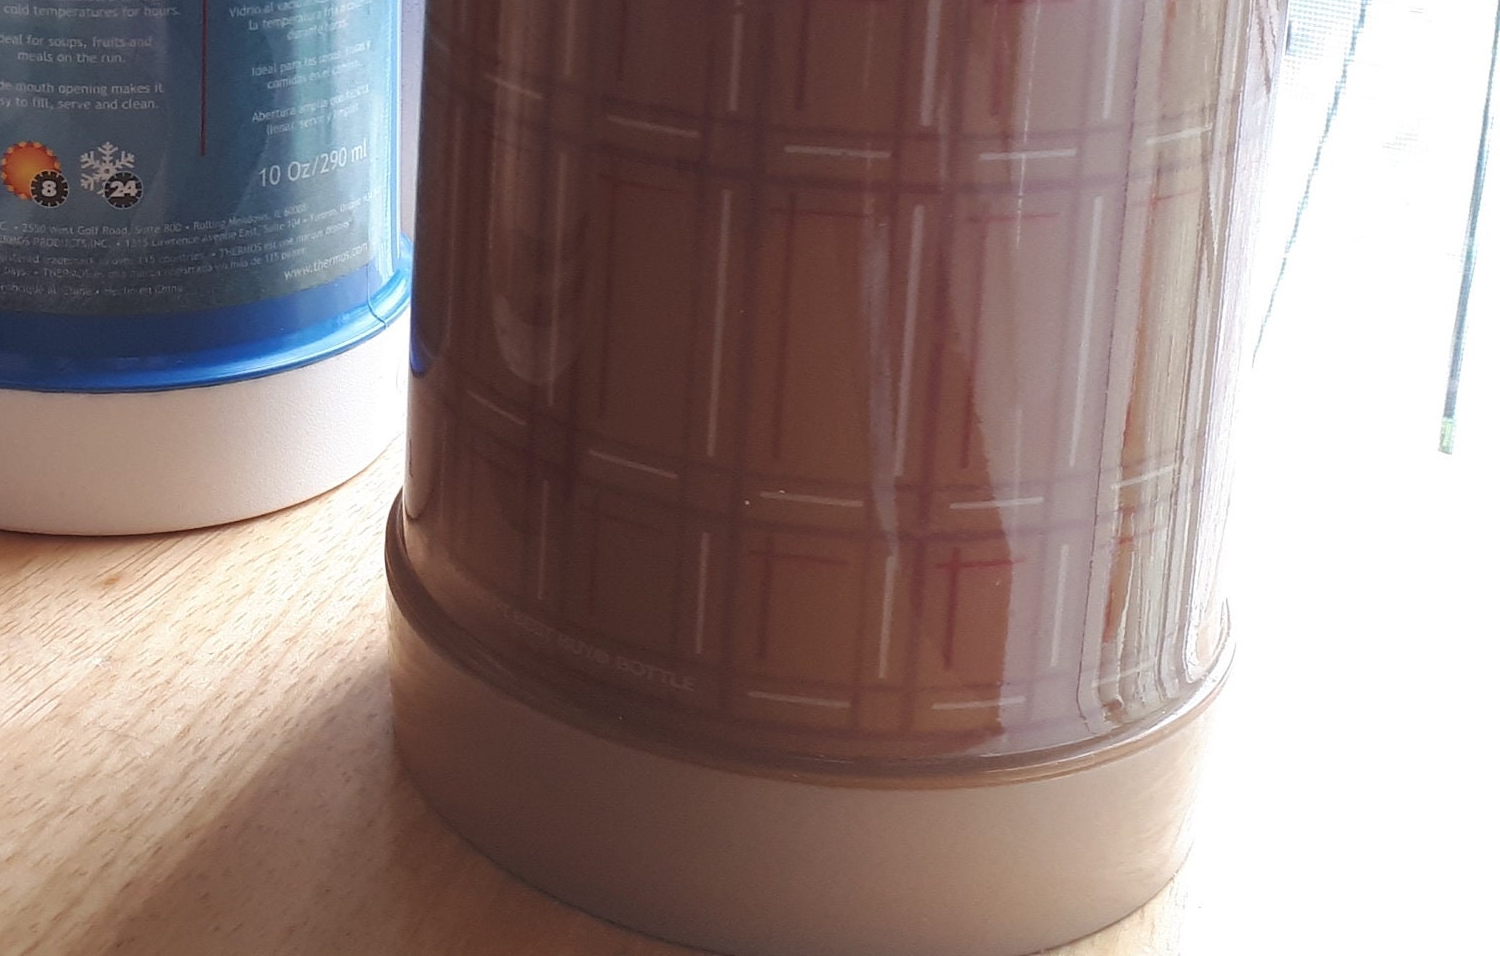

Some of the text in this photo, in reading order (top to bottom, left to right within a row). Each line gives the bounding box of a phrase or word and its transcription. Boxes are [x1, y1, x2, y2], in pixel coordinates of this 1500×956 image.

[3, 3, 29, 15] cold
[33, 5, 118, 19] temperatures
[122, 5, 138, 17] for
[143, 5, 180, 17] hours.
[228, 5, 261, 19] Vidrio
[27, 33, 44, 45] for
[48, 36, 87, 49] soups,
[92, 35, 125, 48] fruits
[130, 35, 153, 48] and
[17, 51, 126, 63] meals on the run.
[15, 82, 54, 93] mouth
[58, 83, 108, 95] opening
[111, 83, 150, 94] makes
[155, 83, 164, 94] it
[15, 96, 28, 107] to
[32, 96, 54, 109] fill,
[58, 100, 91, 110] serve
[95, 98, 118, 109] and
[121, 99, 159, 110] clean.
[251, 107, 297, 124] Abertura
[259, 137, 369, 187] 10 Oz/290 ml
[41, 180, 57, 197] 8
[109, 180, 138, 198] 24
[77, 224, 99, 236] Golf
[219, 242, 262, 258] THERMOS
[283, 242, 369, 280] www.thermos.com
[615, 654, 697, 694] BOTTLE
